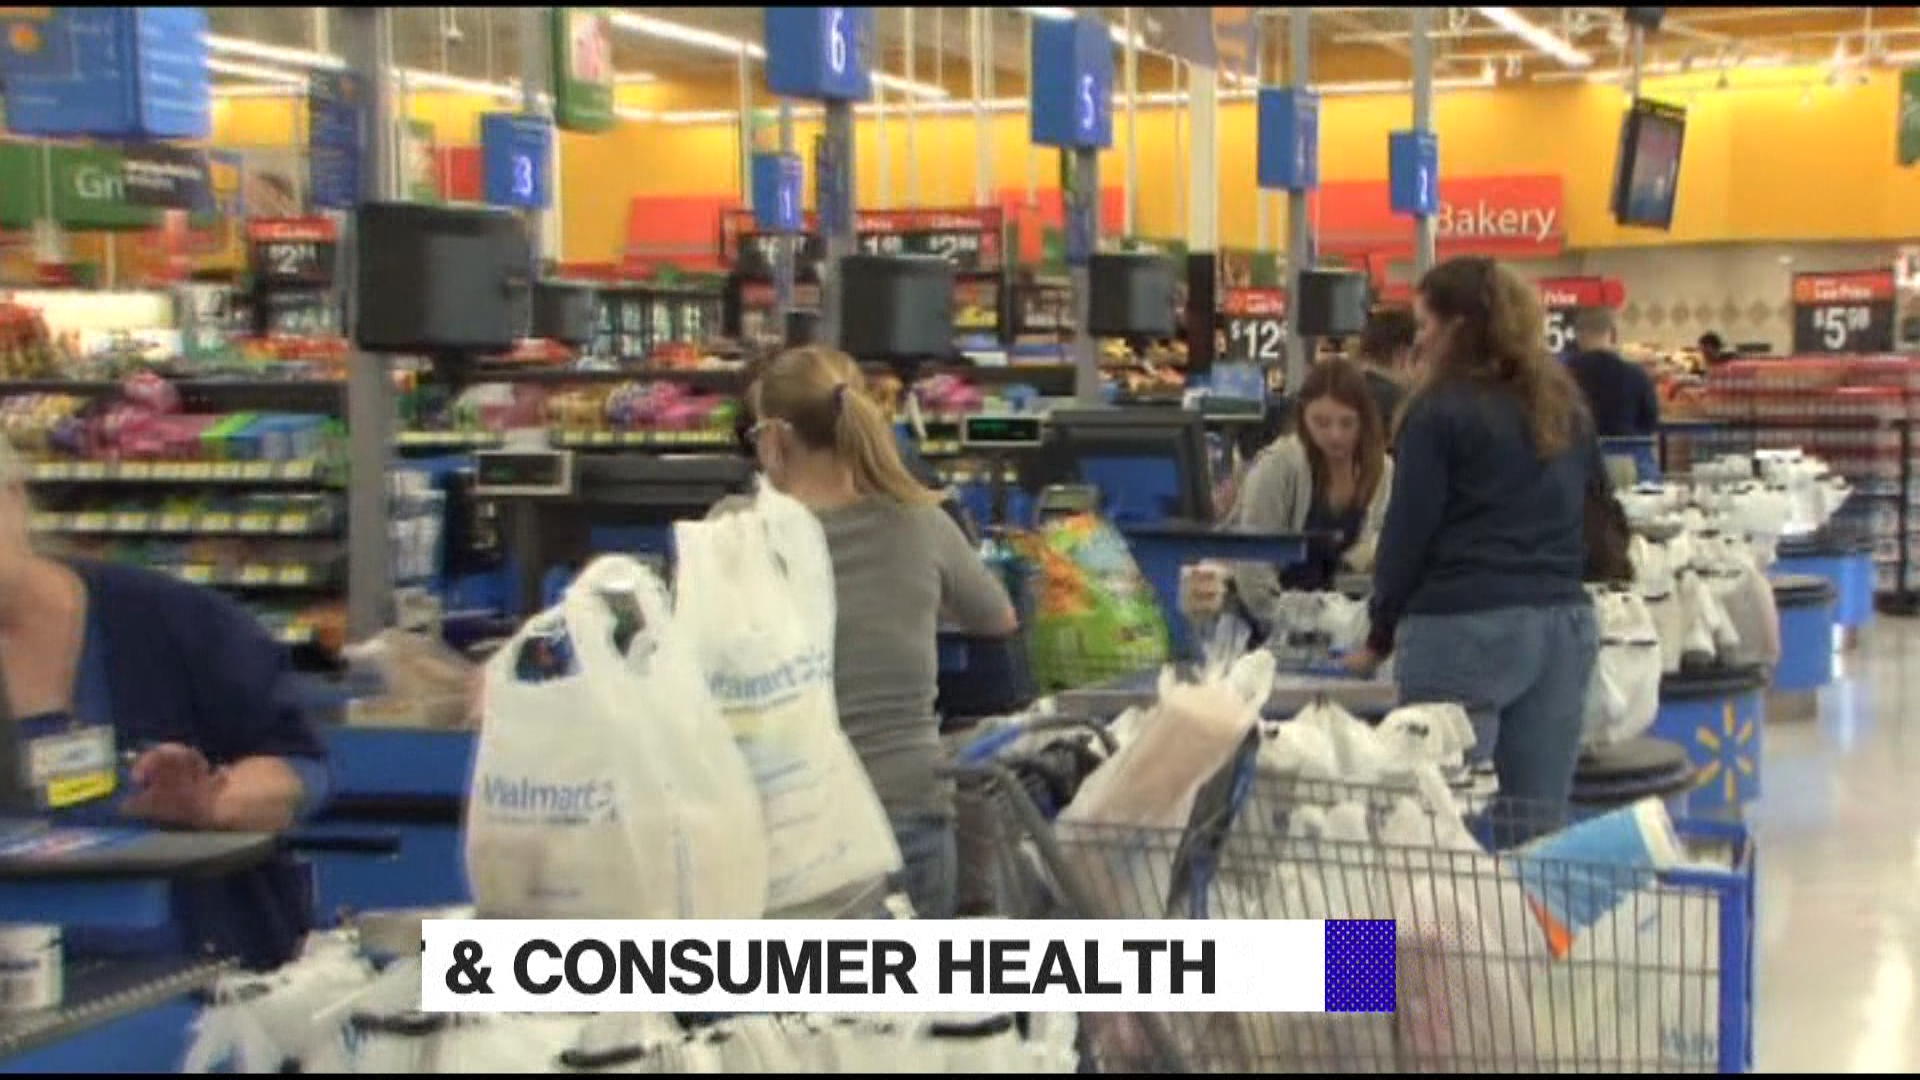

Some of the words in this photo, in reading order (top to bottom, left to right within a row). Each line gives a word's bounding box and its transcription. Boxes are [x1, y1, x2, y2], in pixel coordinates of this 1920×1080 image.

[829, 8, 847, 75] 6
[1080, 74, 1095, 129] 5
[1434, 199, 1557, 243] Bakery
